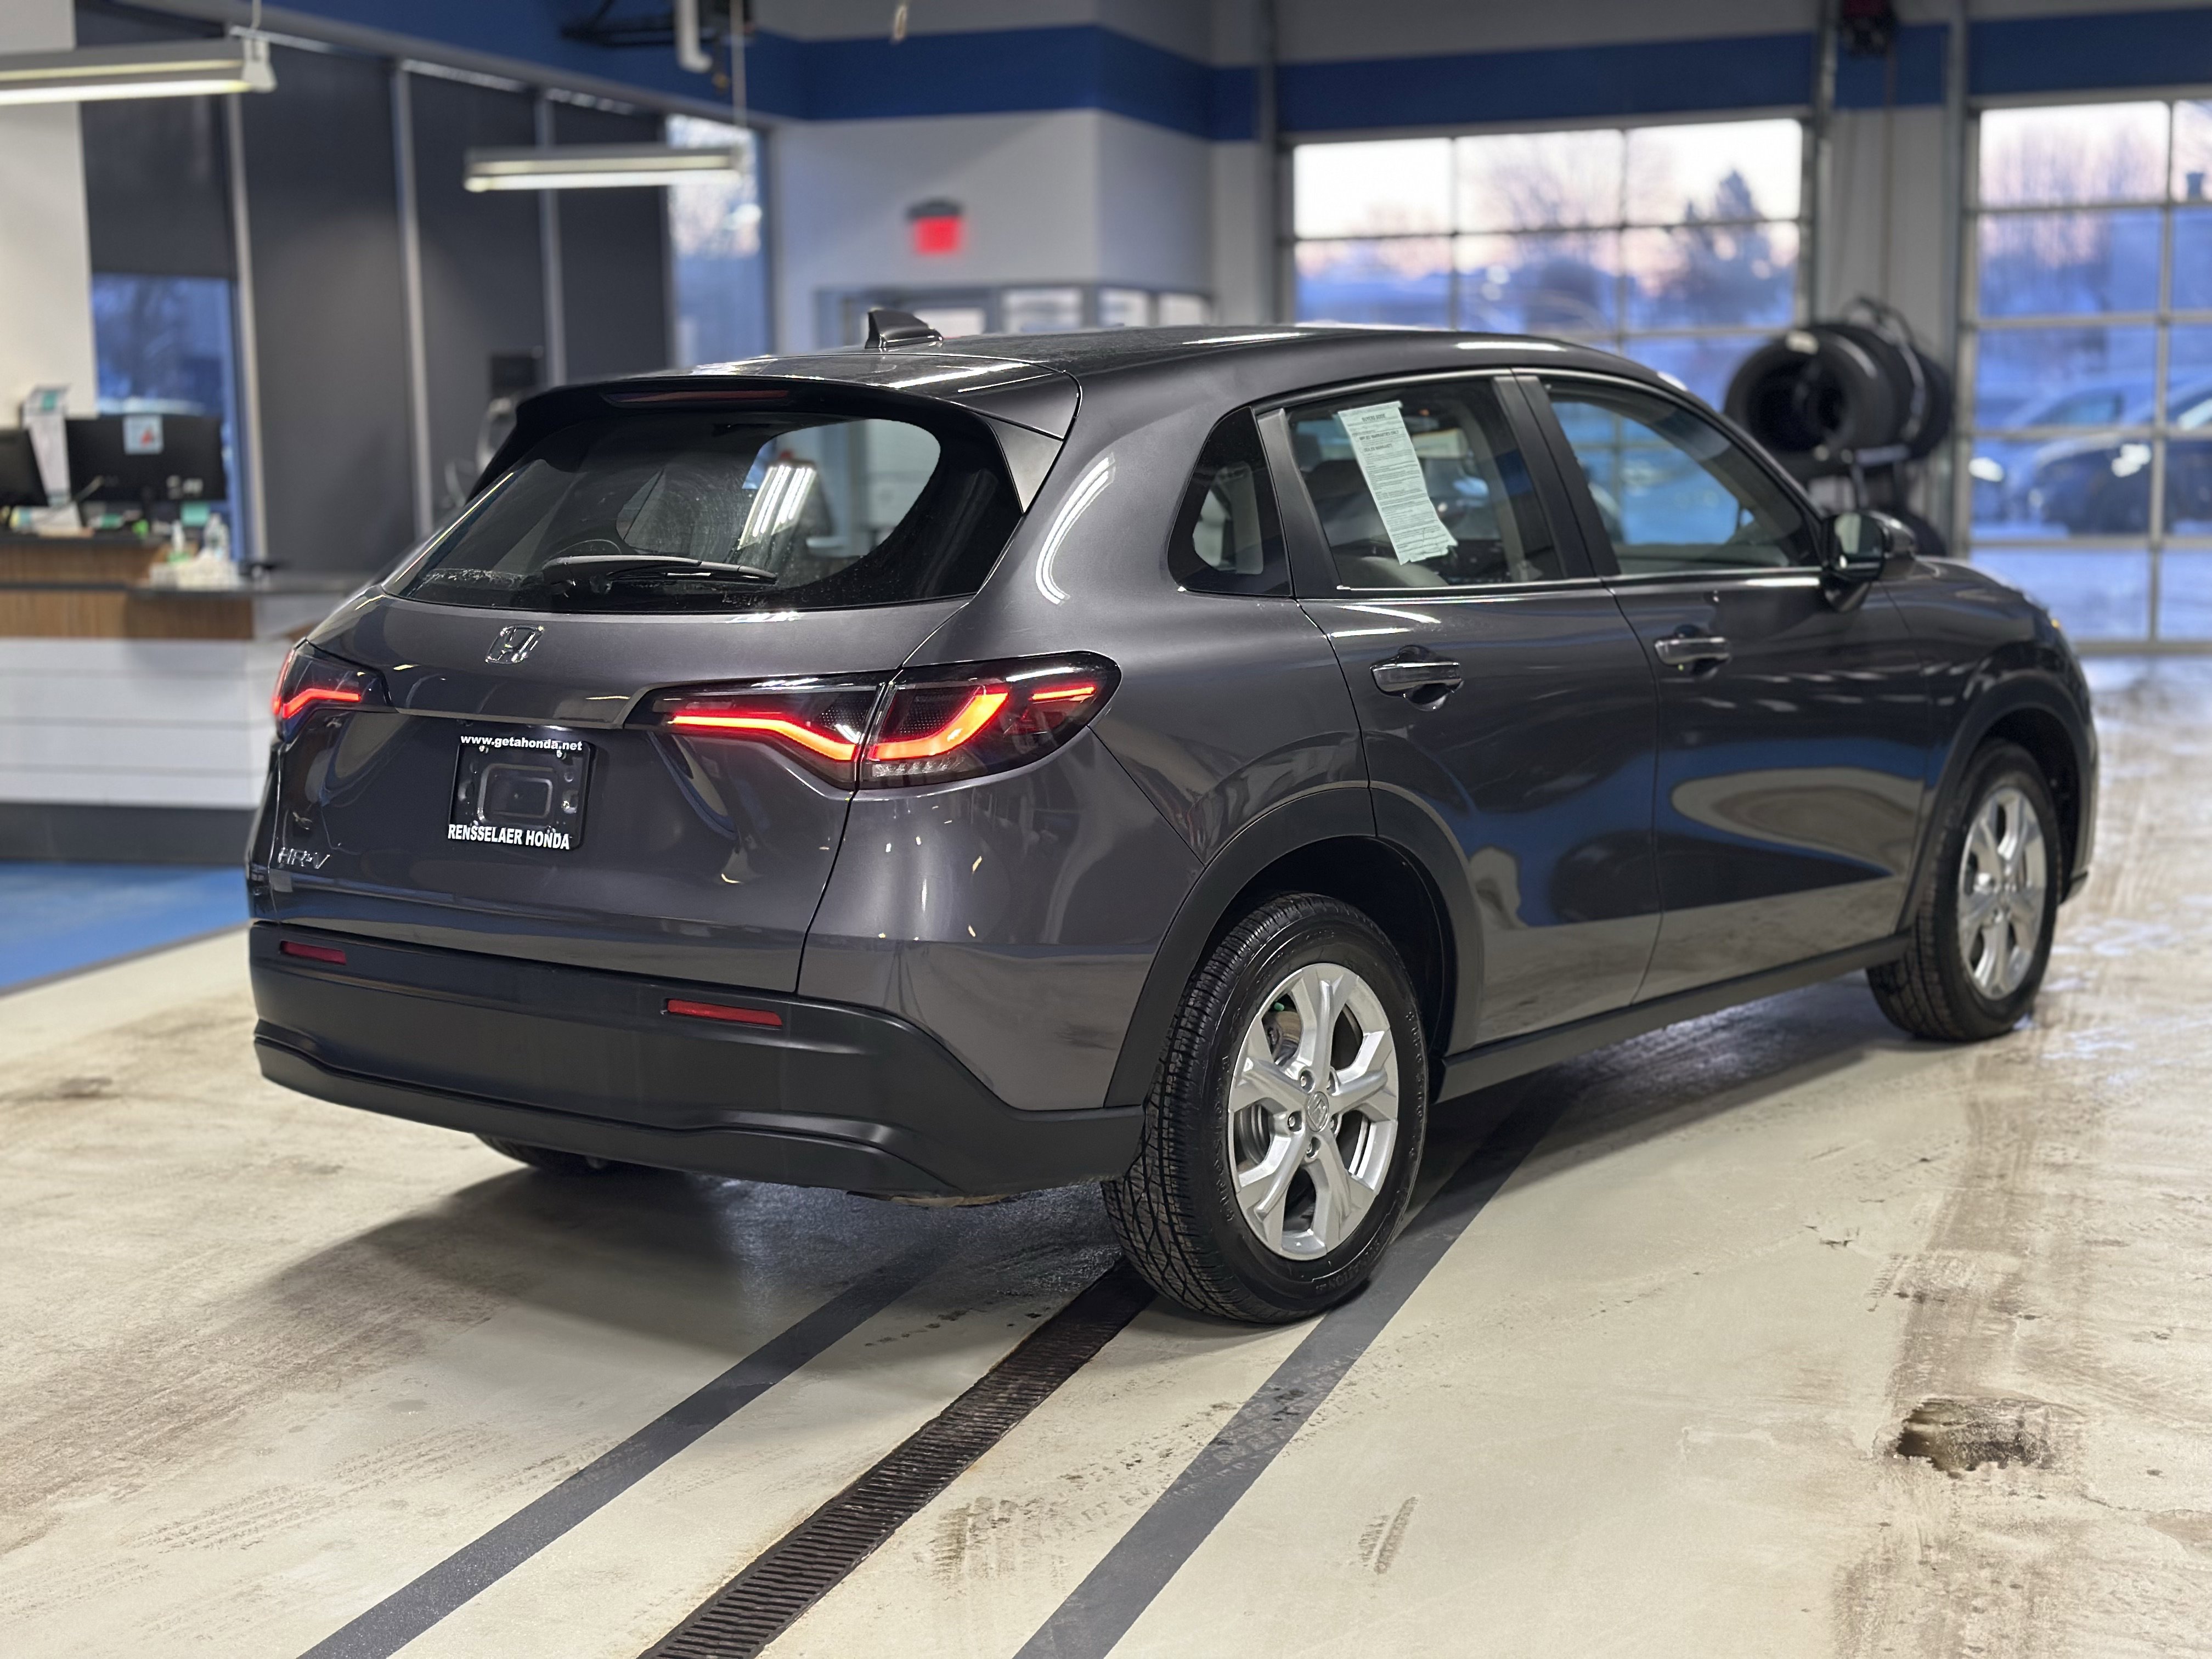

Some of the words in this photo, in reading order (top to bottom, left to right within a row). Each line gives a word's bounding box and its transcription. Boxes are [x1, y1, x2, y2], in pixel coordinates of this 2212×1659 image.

[461, 735, 583, 751] www.getahonda.net
[448, 824, 522, 845] RENSSELAER
[525, 830, 570, 850] HONDA
